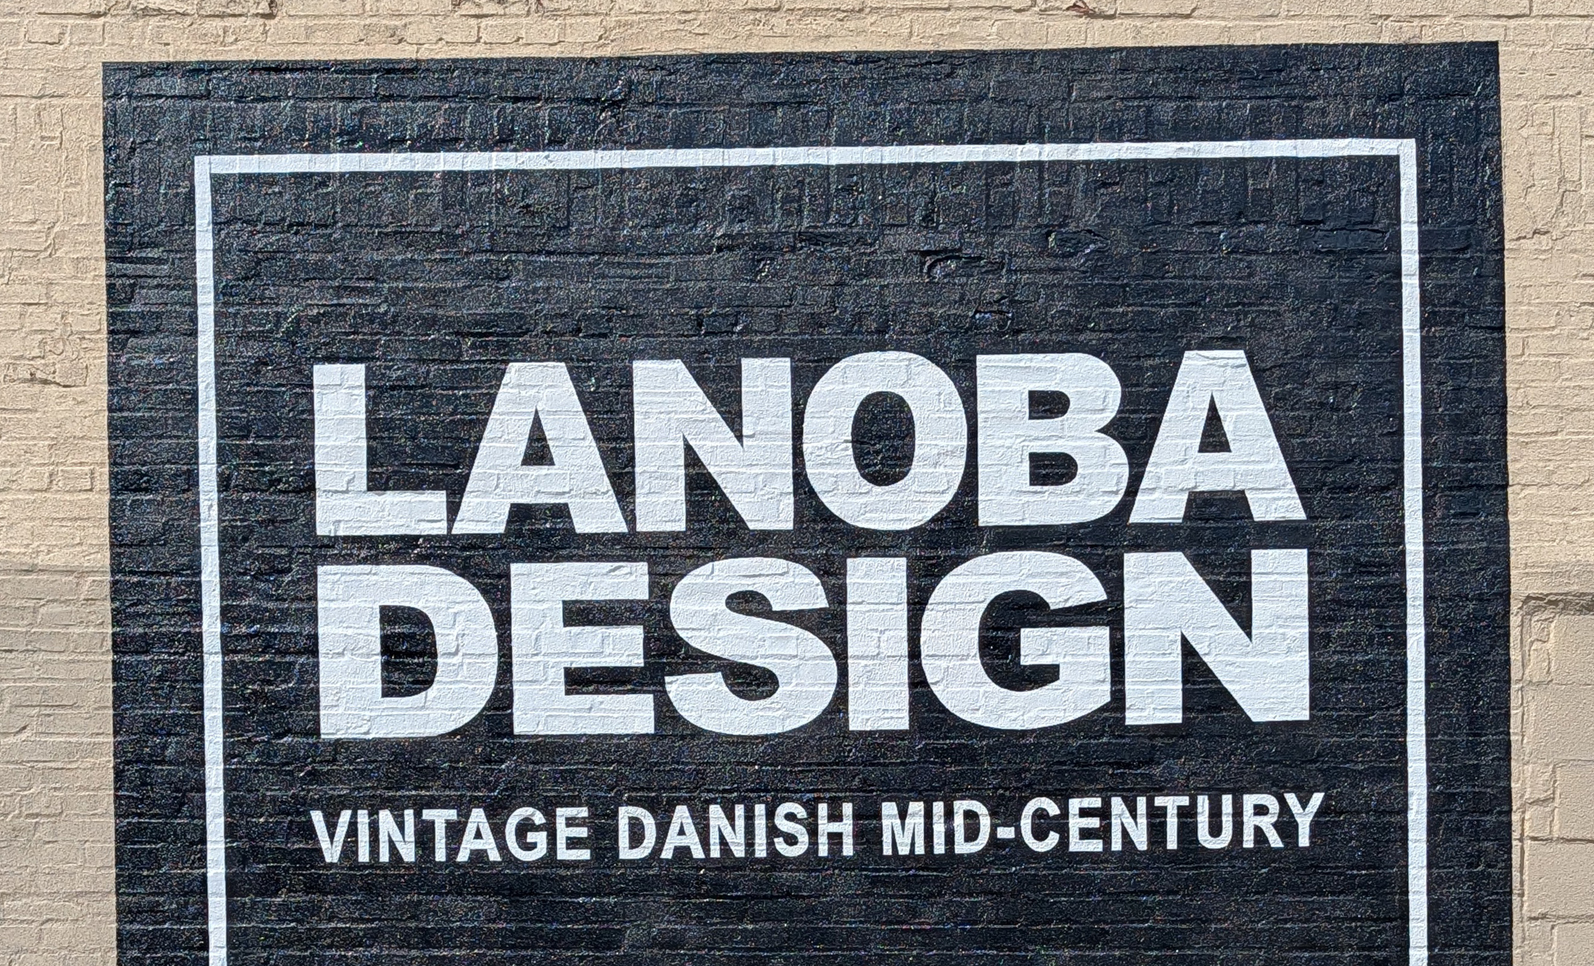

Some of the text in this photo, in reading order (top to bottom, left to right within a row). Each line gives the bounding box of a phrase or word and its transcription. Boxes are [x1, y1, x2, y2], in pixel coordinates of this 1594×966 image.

[313, 350, 1308, 537] LANOBA
[316, 549, 1310, 739] DESIGN
[309, 792, 1325, 863] VINTAGE DANISH MID-CENTURY
